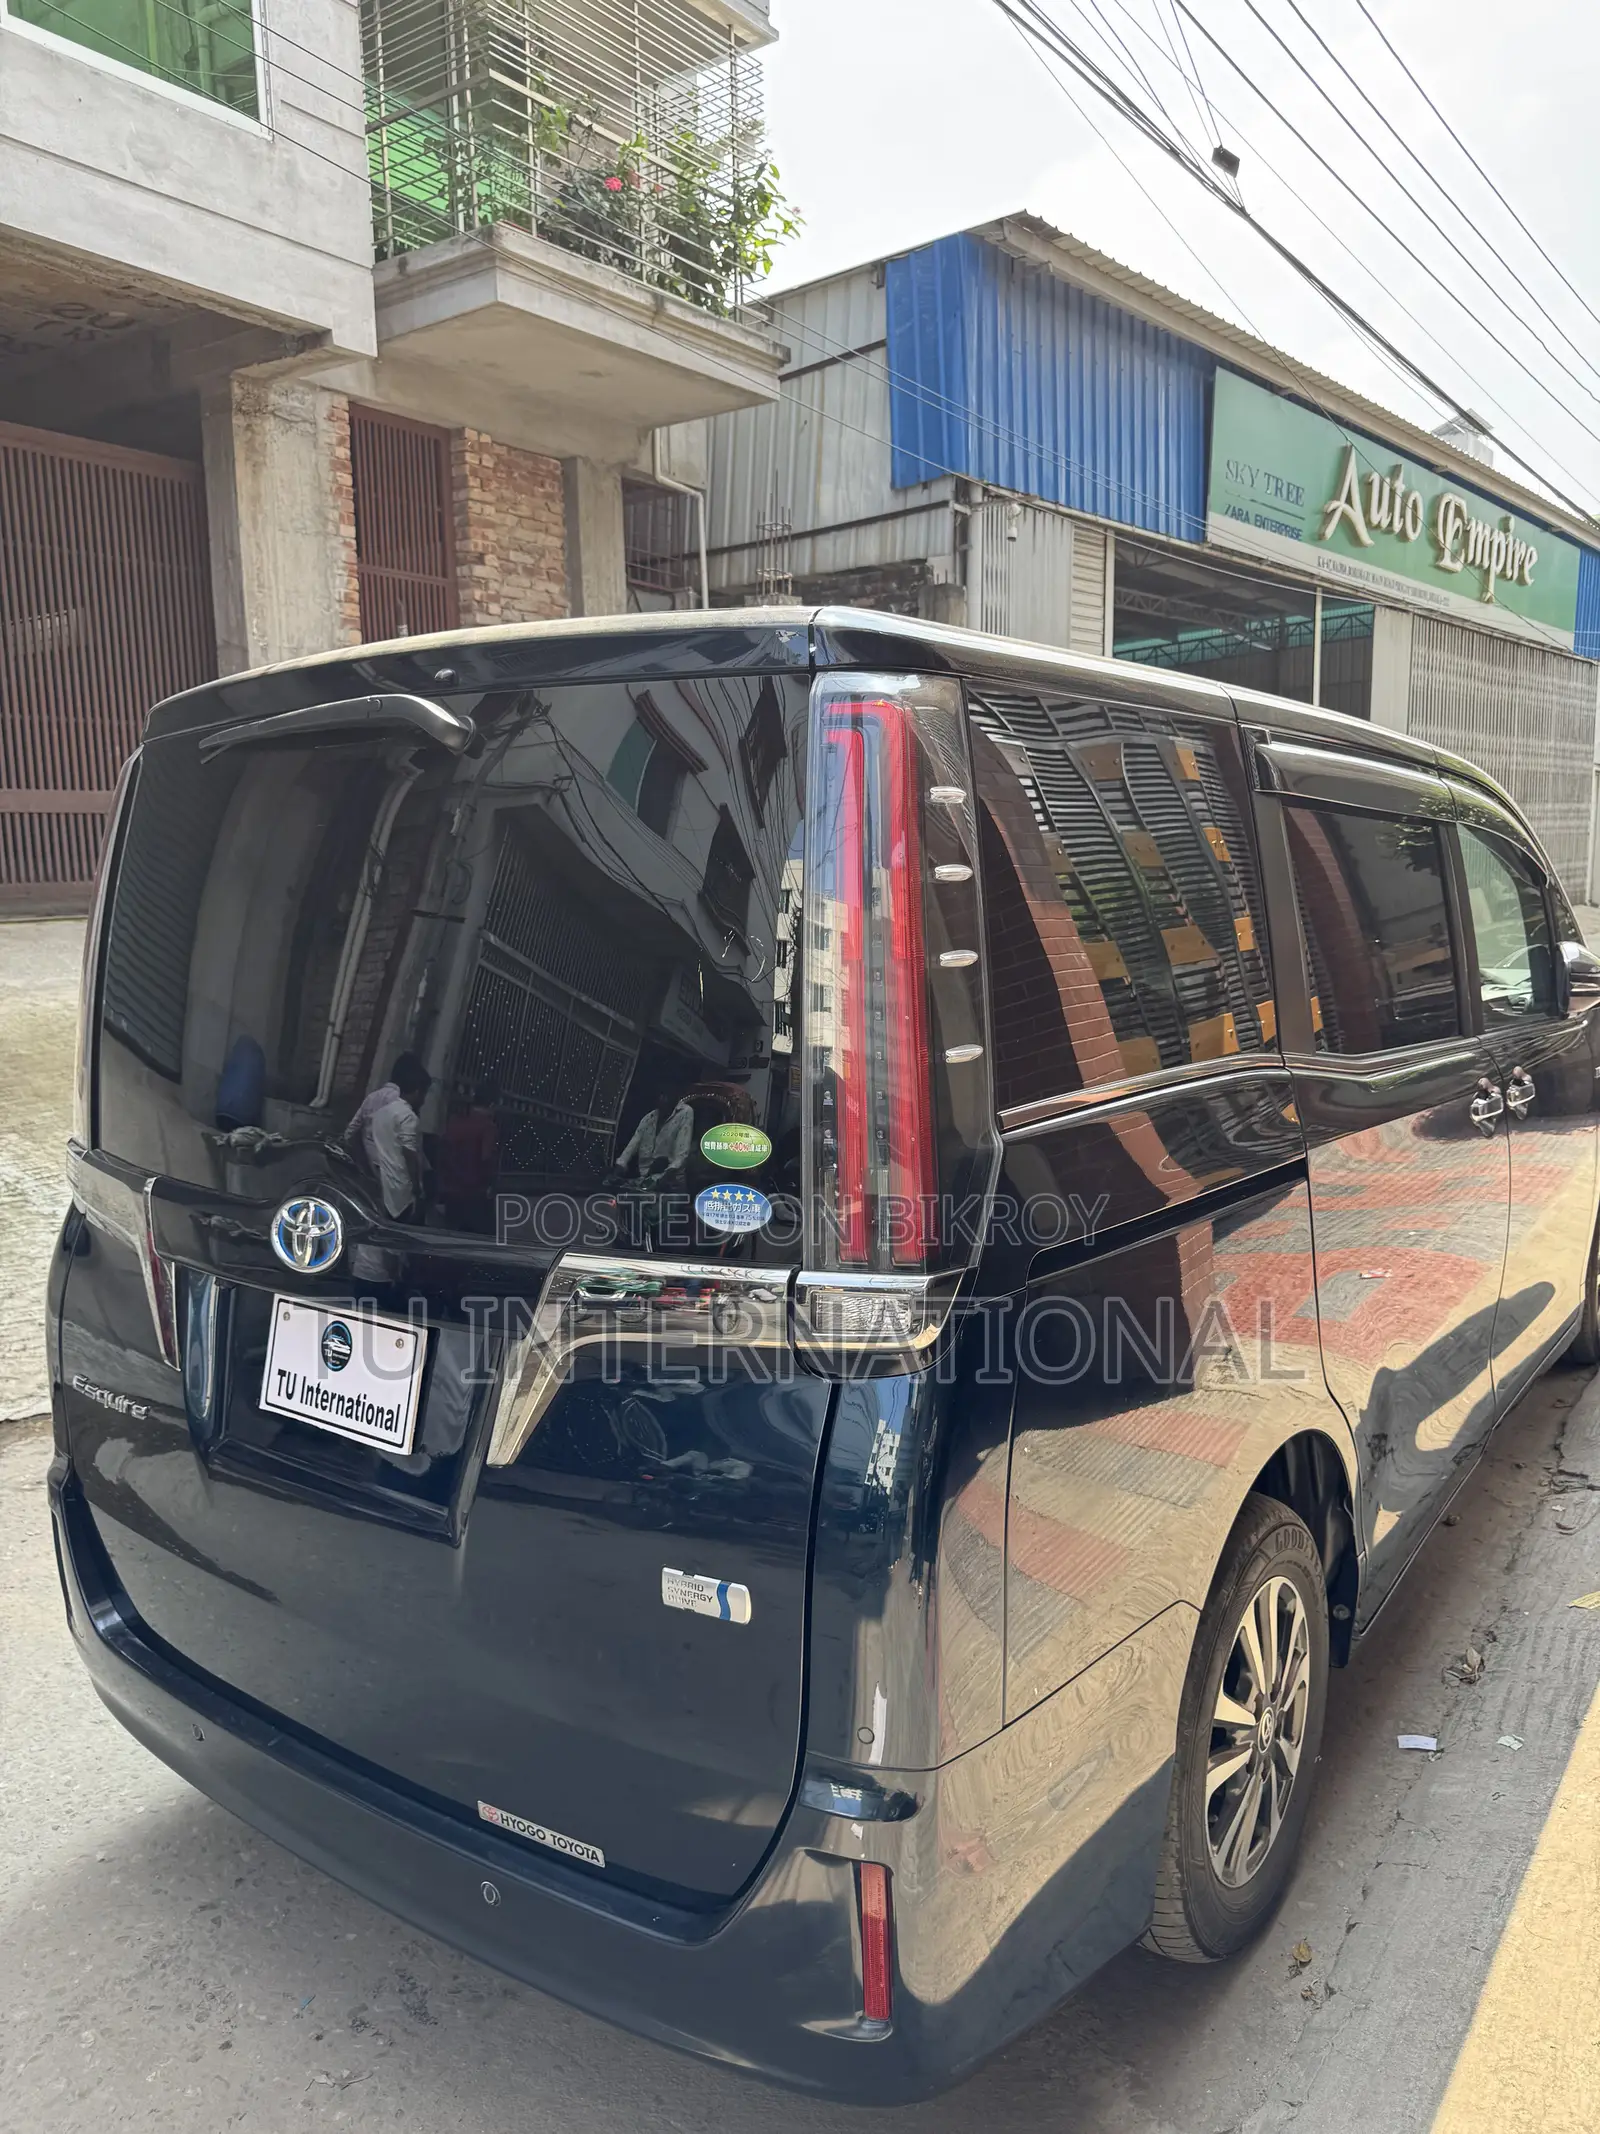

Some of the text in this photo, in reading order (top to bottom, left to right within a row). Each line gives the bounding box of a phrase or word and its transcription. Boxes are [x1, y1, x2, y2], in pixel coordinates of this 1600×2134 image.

[1225, 459, 1305, 508] SKY TREE
[1224, 503, 1304, 542] ZARA ENTERPRISE
[1318, 444, 1424, 547] Auto
[1435, 492, 1539, 603] Empire
[72, 1374, 148, 1421] Esquire
[277, 1368, 401, 1433] TU International
[667, 1577, 704, 1592] HYBRID
[667, 1586, 713, 1603] SYNERGY
[500, 1813, 600, 1863] HYOGO TOYOTA
